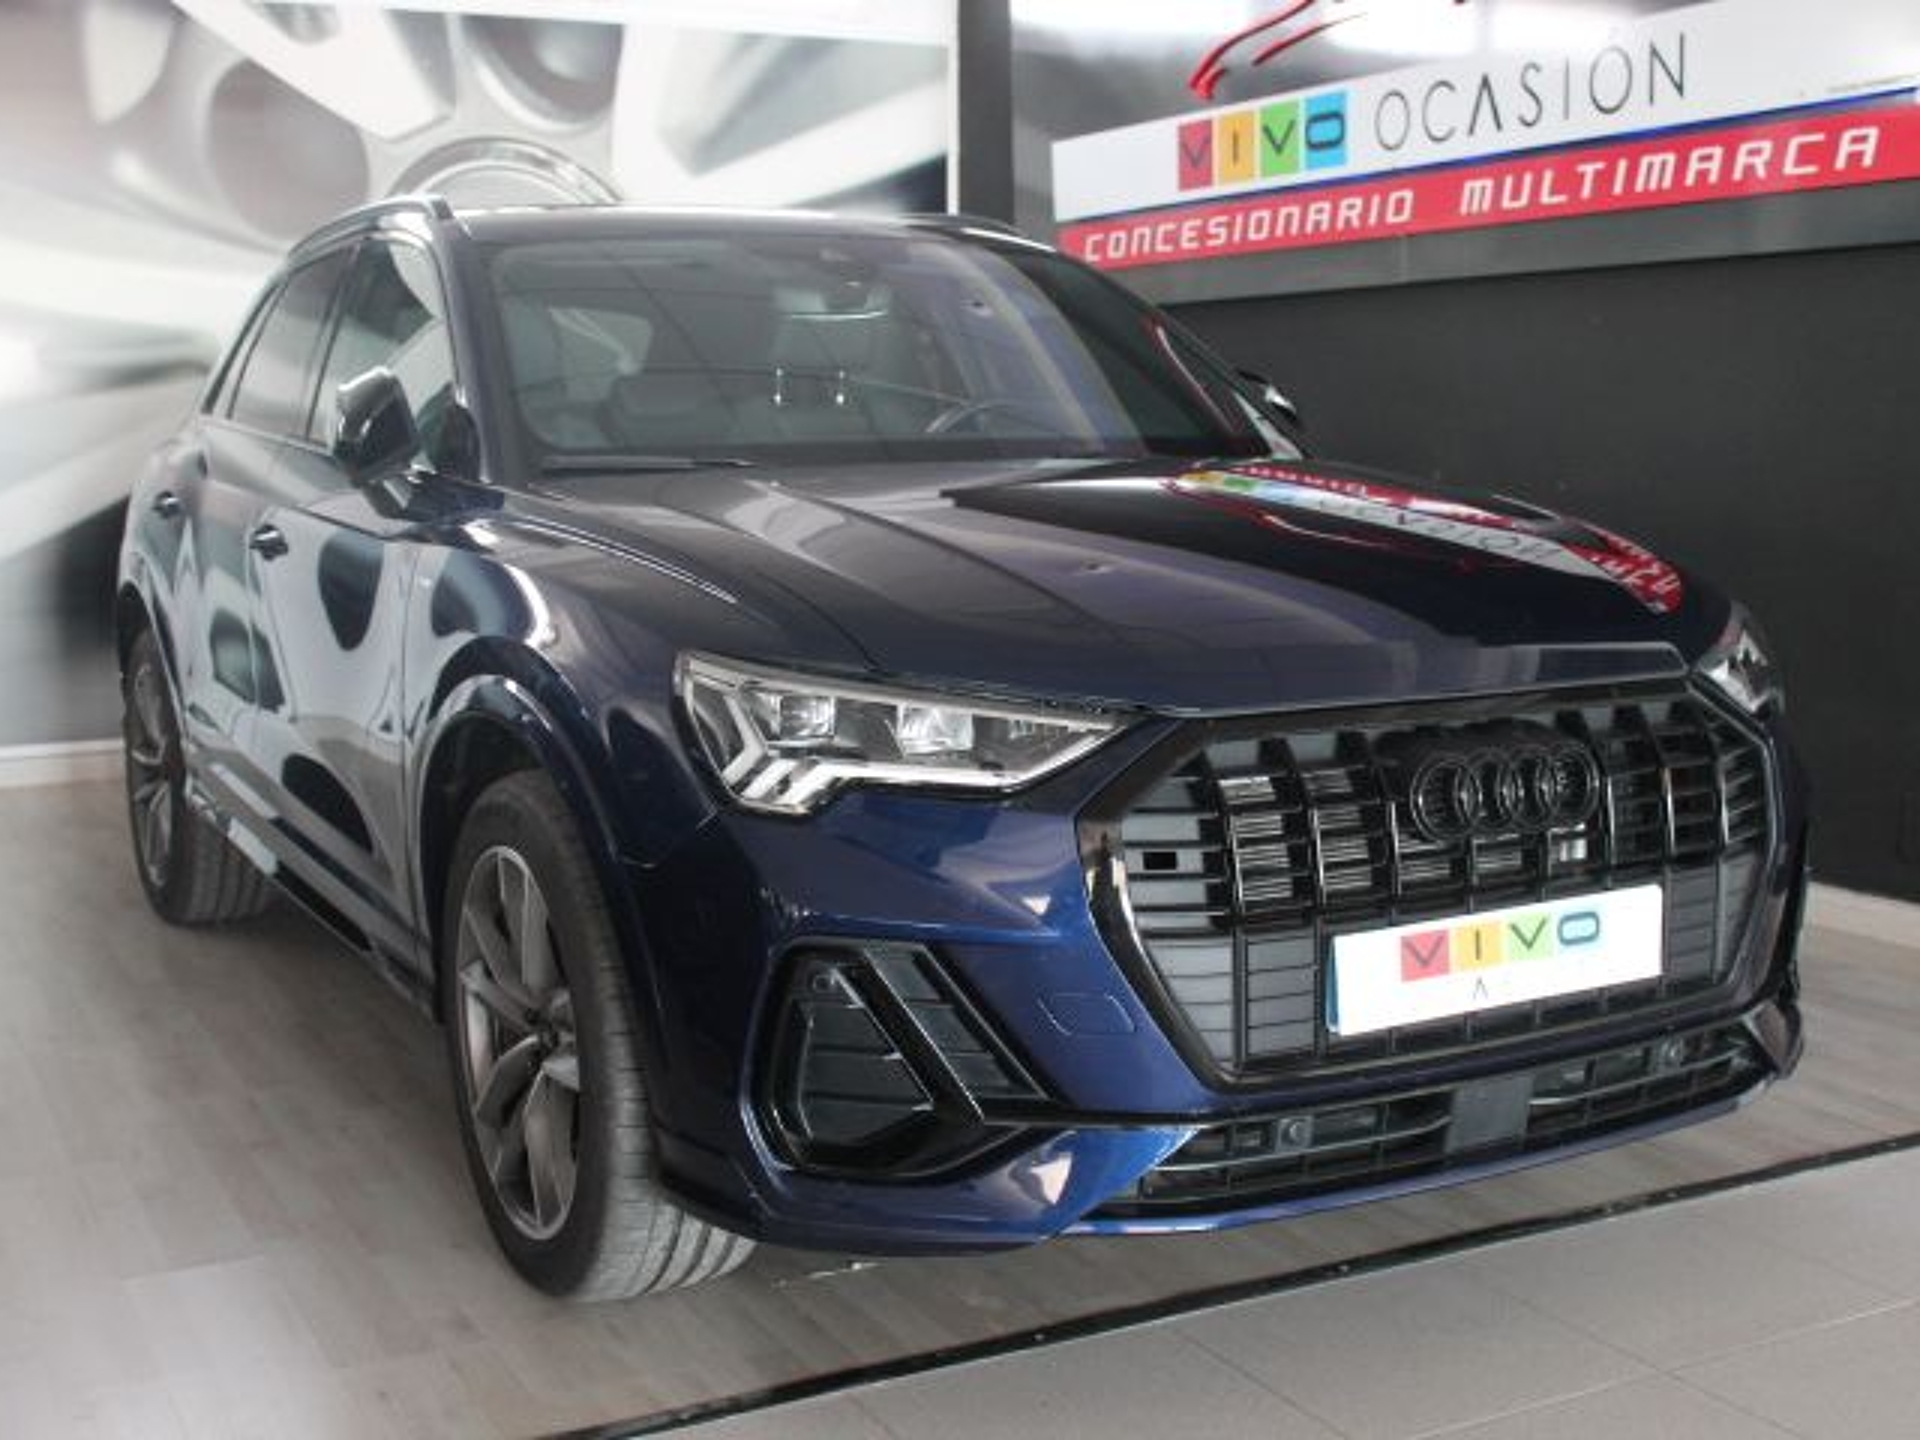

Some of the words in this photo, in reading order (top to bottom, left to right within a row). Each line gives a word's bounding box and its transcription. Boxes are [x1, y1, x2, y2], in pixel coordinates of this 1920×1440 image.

[1181, 111, 1345, 168] VIVO
[1084, 189, 1414, 262] CONCESIONARIO
[1460, 126, 1879, 216] MULTIMARCA
[1402, 911, 1600, 967] VIVO
